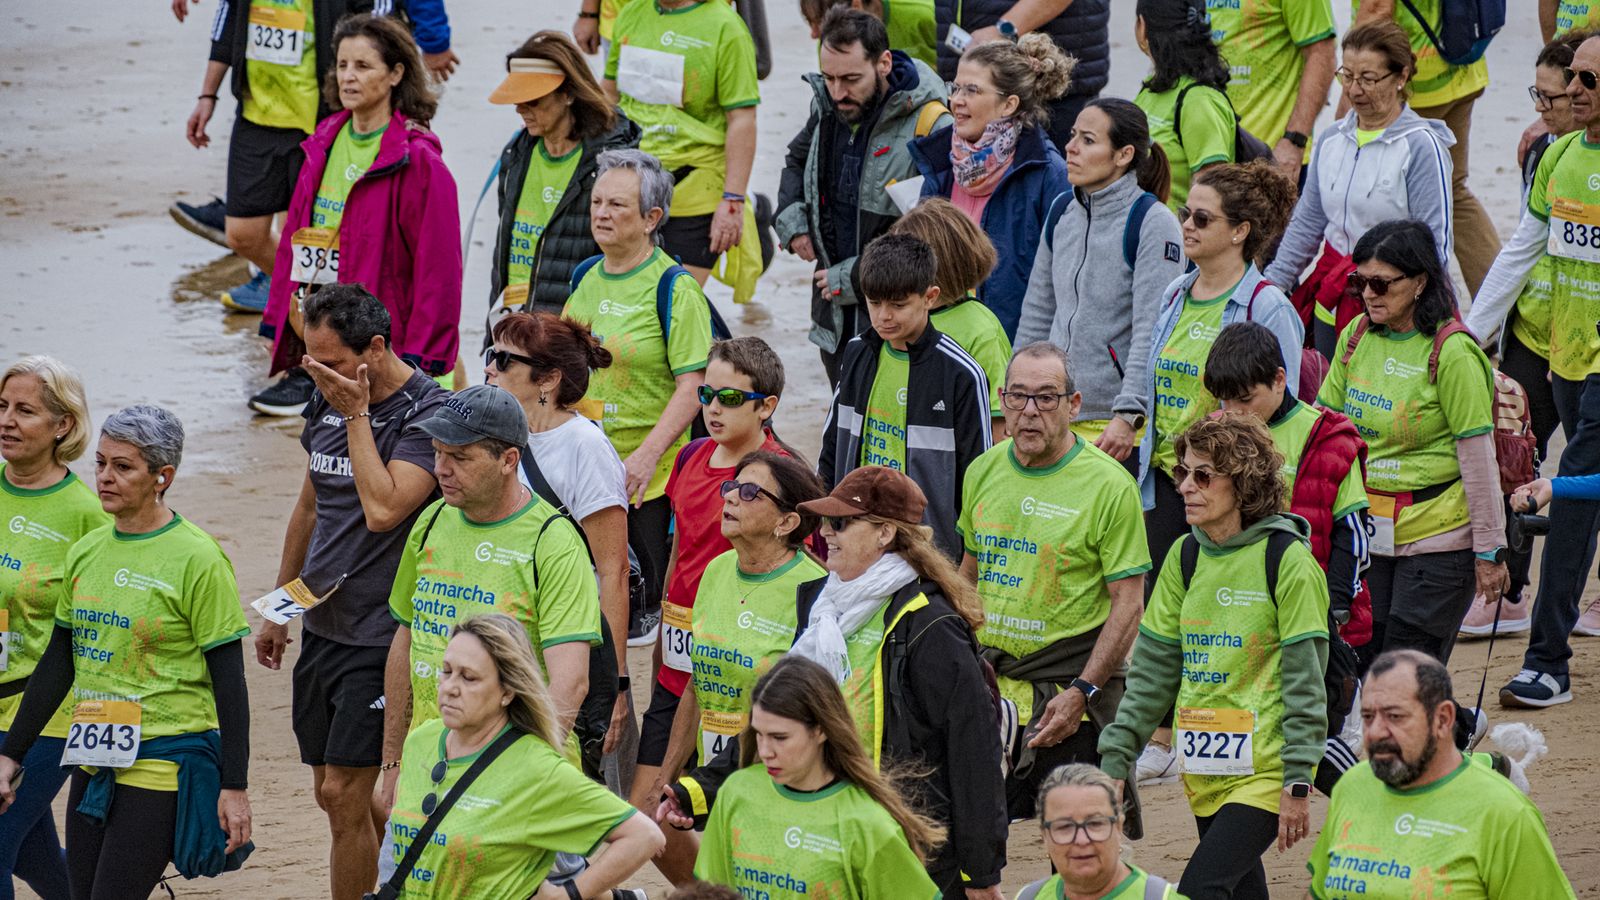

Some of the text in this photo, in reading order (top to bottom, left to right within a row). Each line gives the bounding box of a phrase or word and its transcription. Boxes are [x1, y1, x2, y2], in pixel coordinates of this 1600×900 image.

[255, 25, 297, 52] 3231
[1348, 386, 1393, 411] marcha
[985, 535, 1037, 555] marcha
[432, 581, 495, 605] marcha
[75, 608, 130, 629] marcha
[987, 612, 1046, 632] HYUNDAI
[1186, 631, 1243, 648] marcha
[696, 643, 753, 669] marcha
[67, 723, 135, 752] 2643
[1183, 730, 1248, 760] 3227
[744, 867, 807, 894] marcha
[1342, 859, 1412, 879] marcha
